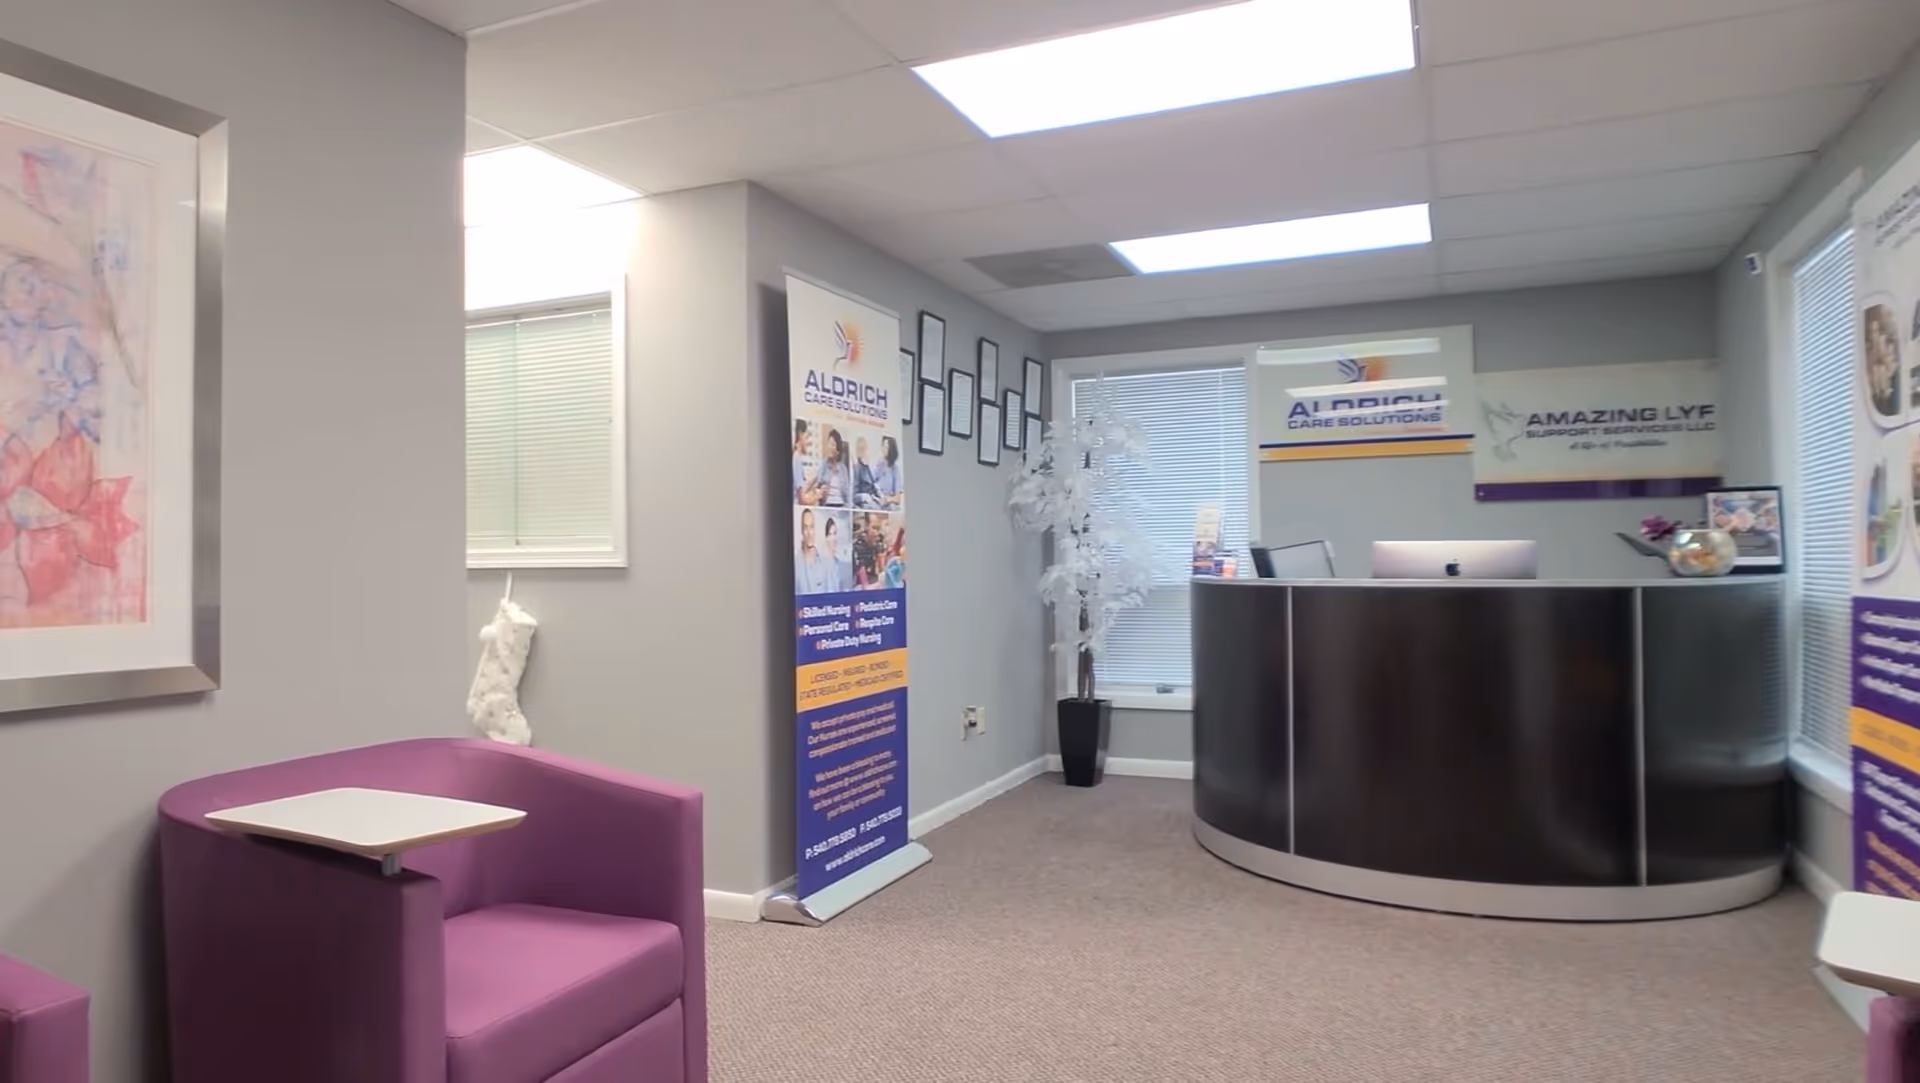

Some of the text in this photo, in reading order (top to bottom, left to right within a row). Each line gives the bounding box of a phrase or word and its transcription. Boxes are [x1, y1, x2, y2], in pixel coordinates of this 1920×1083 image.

[805, 369, 888, 409] ALDRICH
[804, 391, 834, 407] CARE
[836, 399, 888, 420] SOLUTIONS
[1288, 412, 1441, 429] CARE SOLUTIONS
[1526, 404, 1715, 427] AMAZING LYF
[1526, 421, 1716, 438] SUPPORT SERVICES LLC
[803, 605, 850, 618] Skilled Nursing
[803, 621, 848, 635] Personal Care
